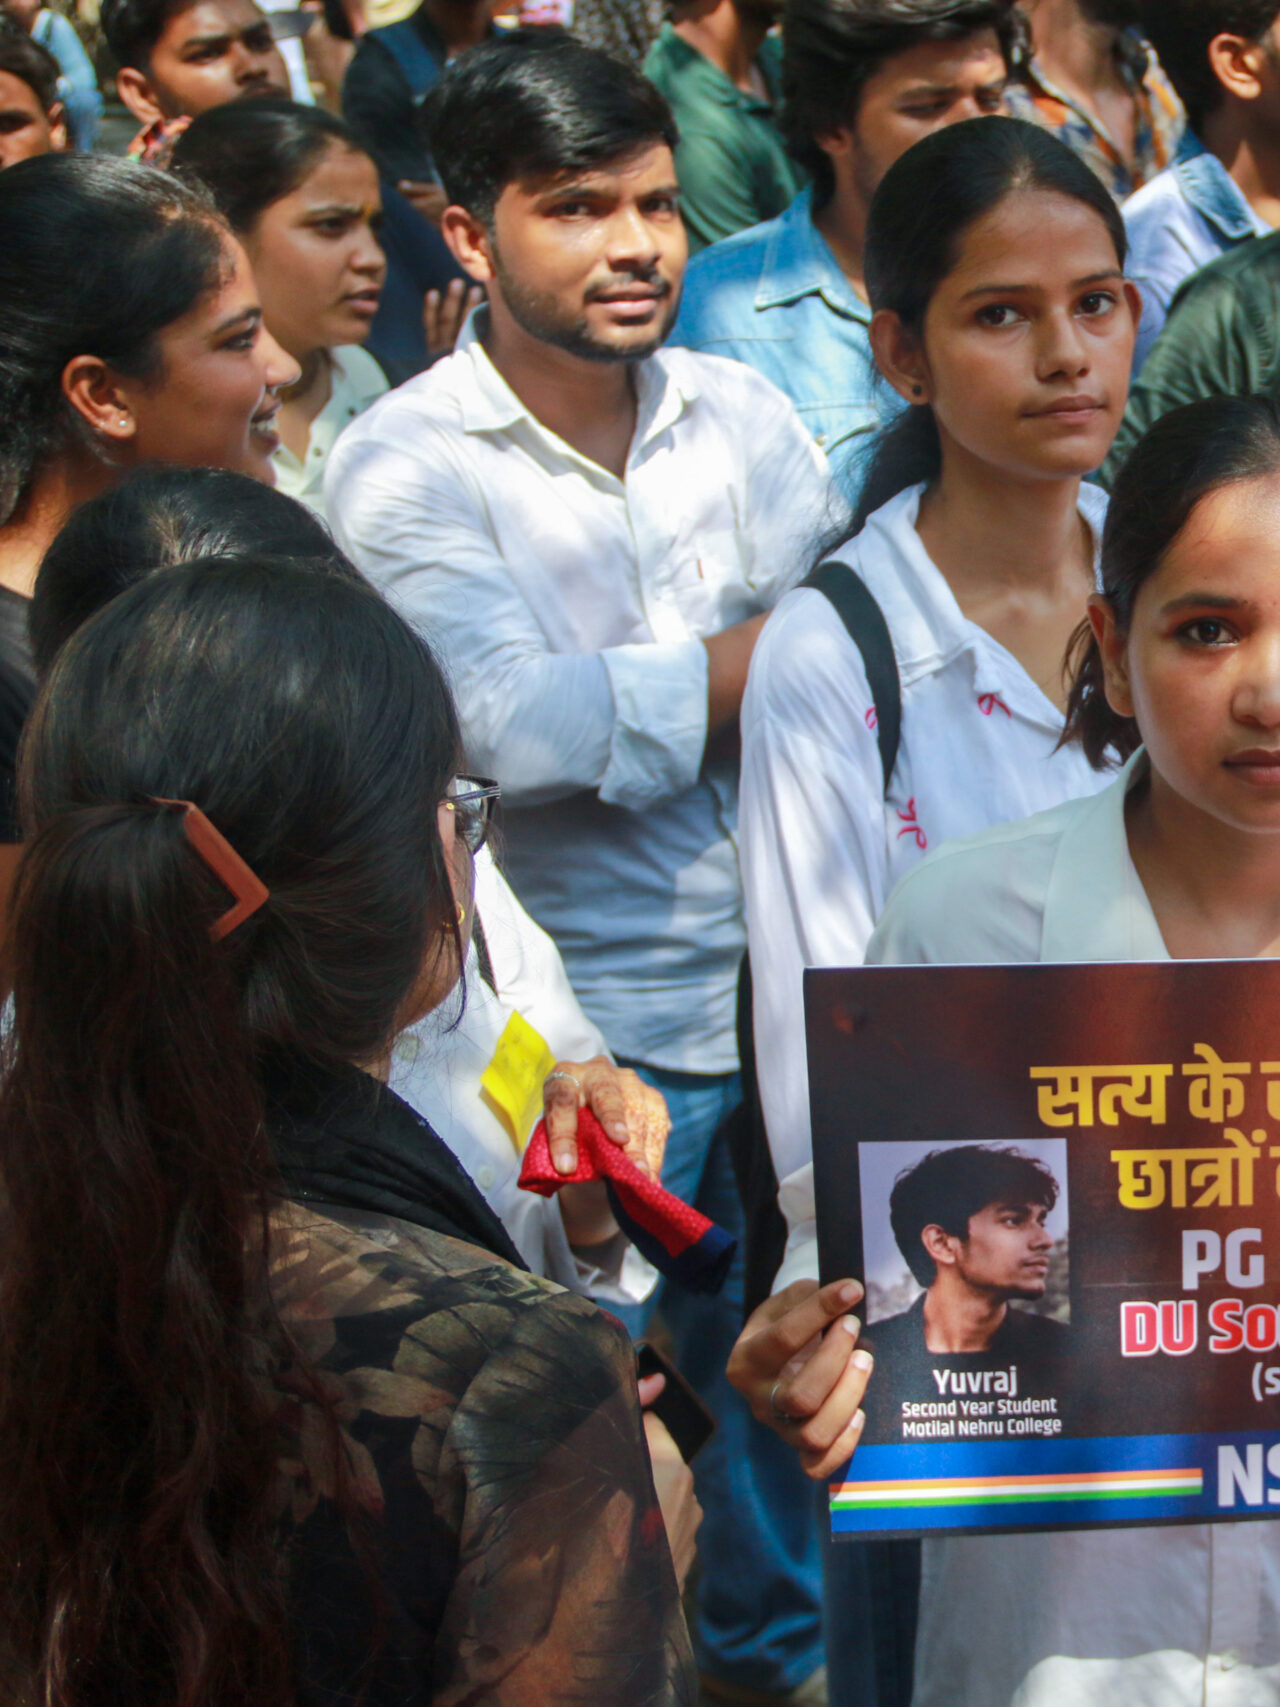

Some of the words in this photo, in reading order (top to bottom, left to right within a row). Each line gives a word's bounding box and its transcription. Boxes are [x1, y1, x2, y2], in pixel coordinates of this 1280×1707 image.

[1029, 1063, 1174, 1128] सत्य
[1182, 1043, 1251, 1123] के
[1110, 1126, 1267, 1210] छात्रों
[1182, 1228, 1265, 1290] PG
[1120, 1300, 1198, 1357] DU
[902, 1400, 957, 1418] Second
[960, 1400, 994, 1416] Year
[997, 1397, 1057, 1415] Student
[932, 1365, 1018, 1397] Yuvraj
[902, 1419, 955, 1438] Motilal
[957, 1418, 1004, 1436] Nehru
[1007, 1416, 1062, 1436] College
